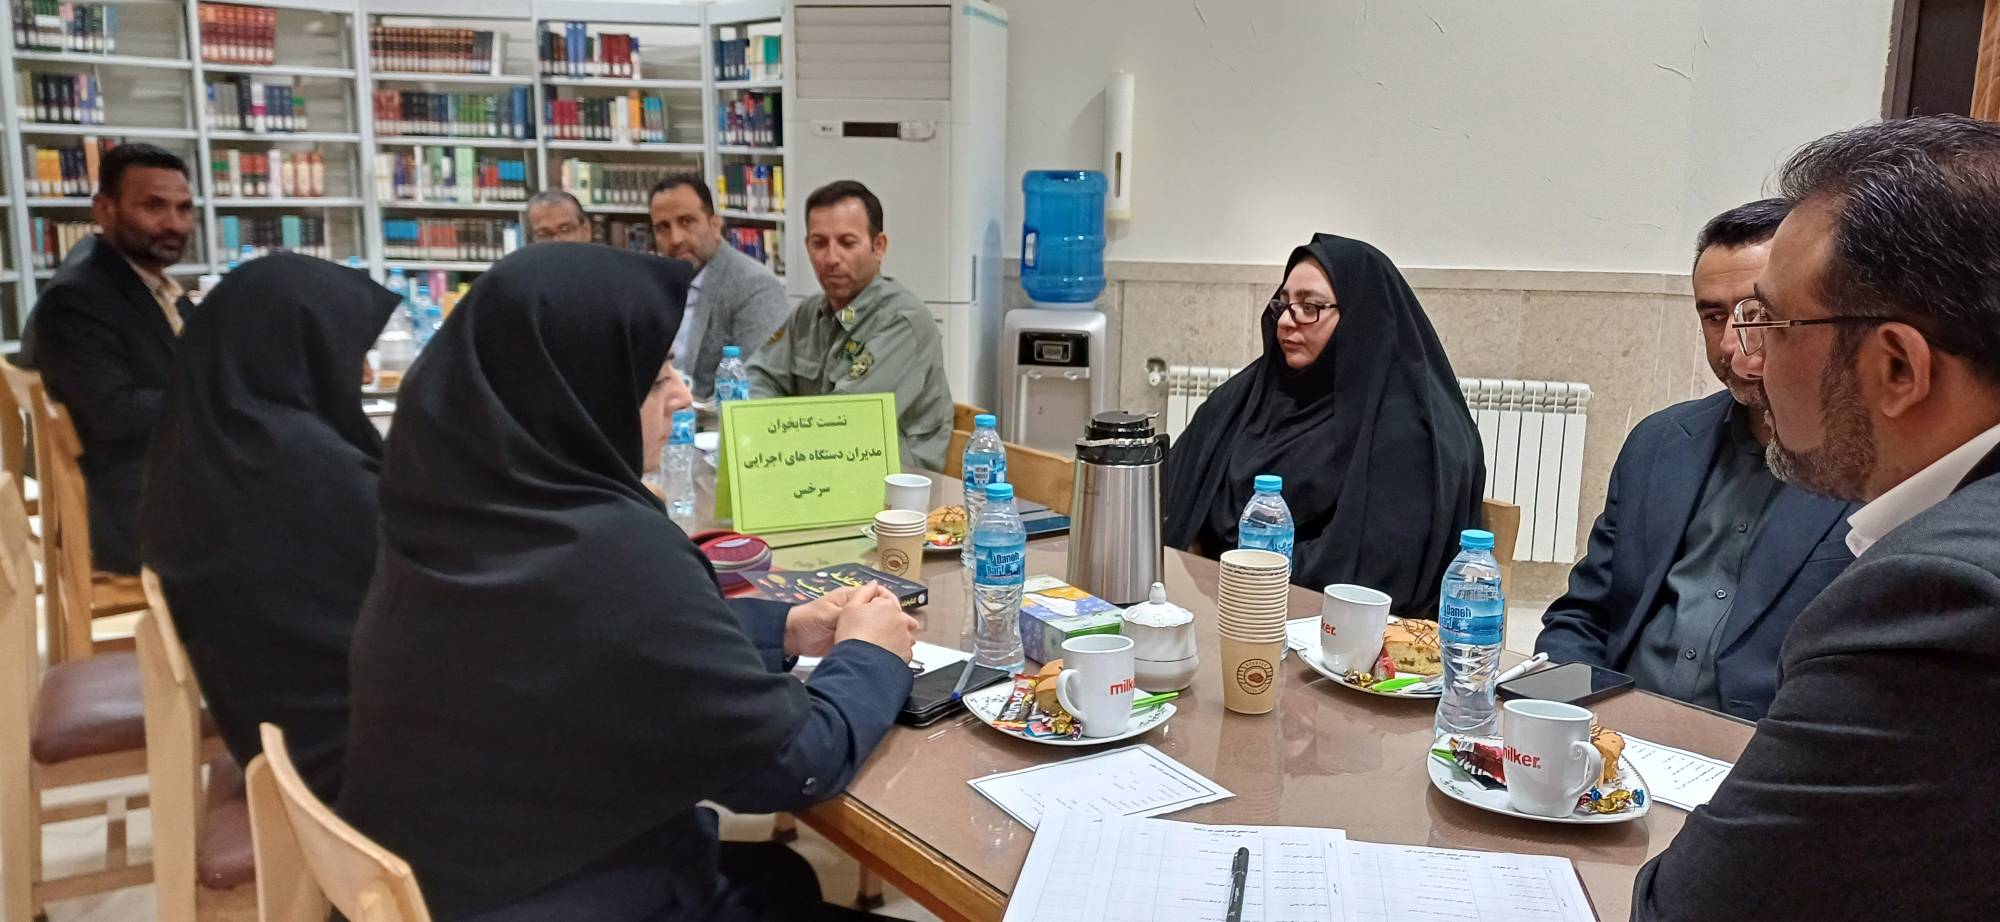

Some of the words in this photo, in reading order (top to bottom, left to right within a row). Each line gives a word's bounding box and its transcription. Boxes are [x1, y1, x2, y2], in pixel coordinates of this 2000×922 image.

[767, 416, 814, 434] کتابخوان
[817, 414, 847, 428] نشست
[744, 451, 782, 469] اجرایی
[785, 450, 806, 466] های
[809, 449, 844, 461] دستگاه
[846, 447, 882, 462] مدیران
[793, 482, 831, 499] سرخس
[995, 551, 1020, 566] Daneh
[1446, 604, 1472, 619] Daneh
